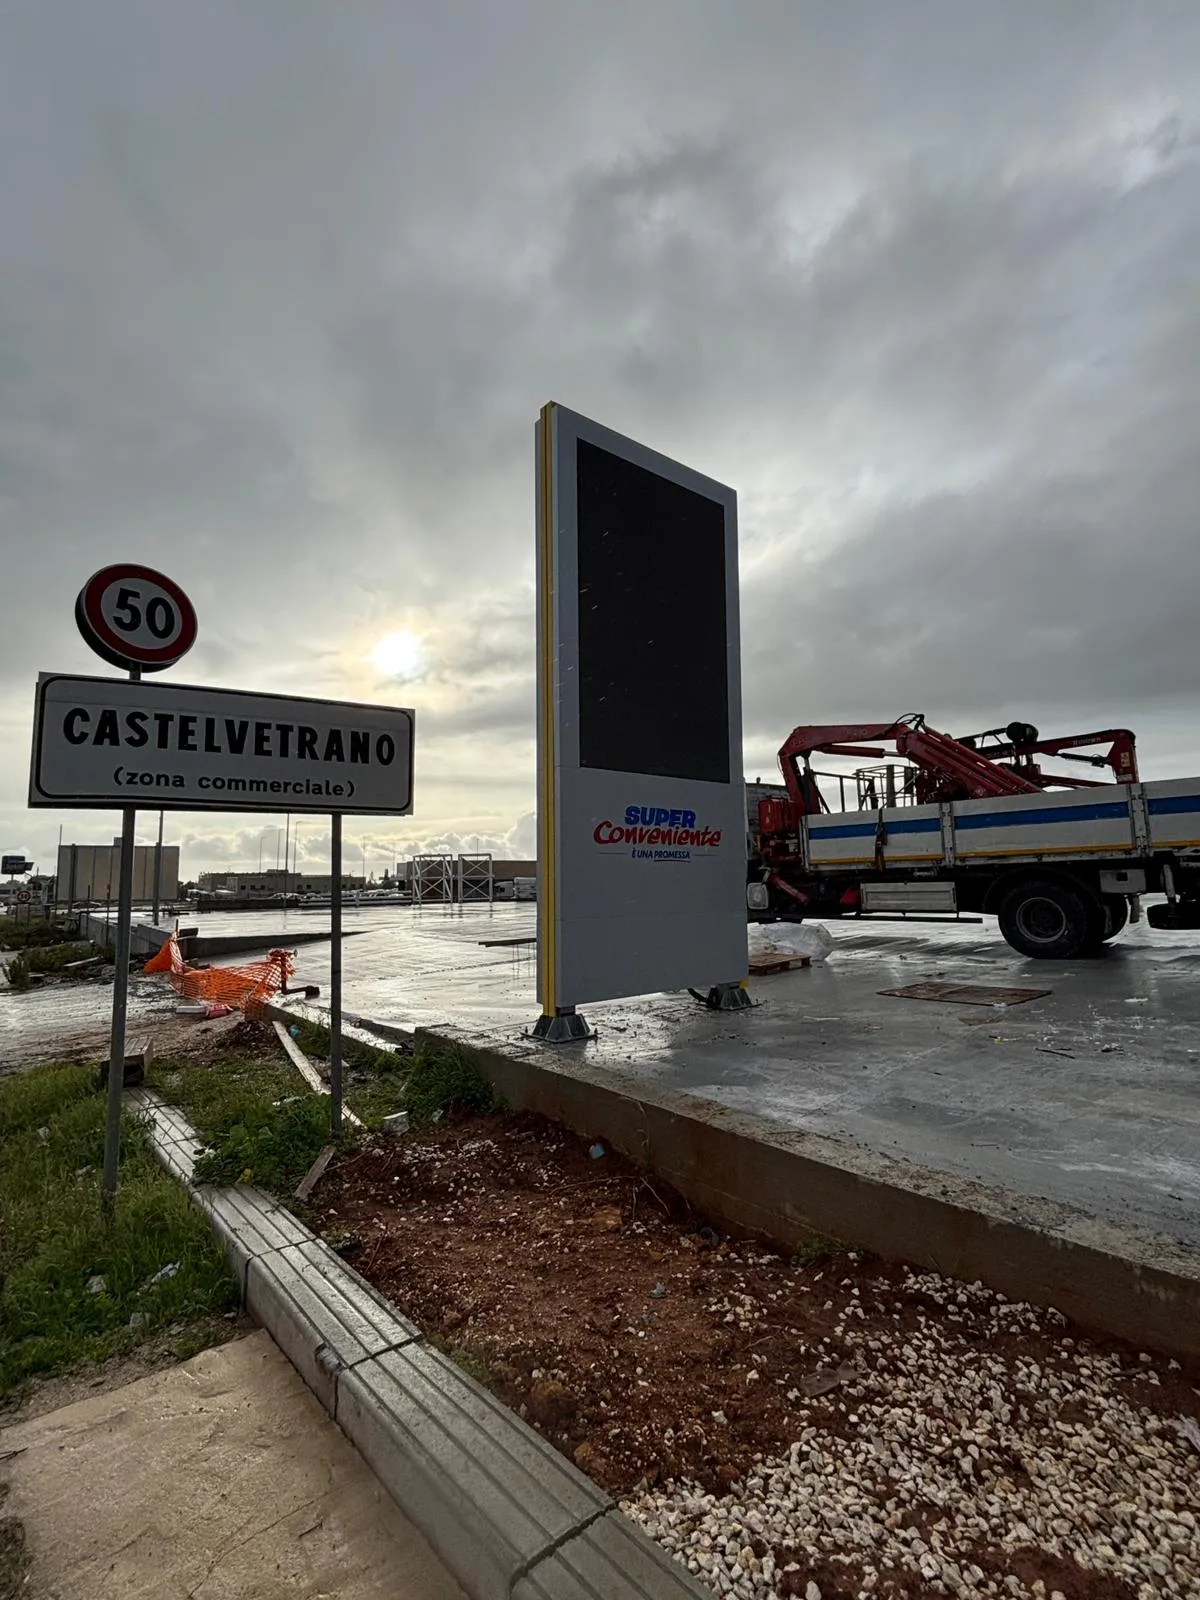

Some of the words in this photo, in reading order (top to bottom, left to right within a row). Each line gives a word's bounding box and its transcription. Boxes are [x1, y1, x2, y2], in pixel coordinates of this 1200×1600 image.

[112, 588, 175, 639] 50
[63, 707, 395, 766] CASTELVETRANO
[113, 766, 185, 789] (zona
[198, 775, 355, 797] commerciale)
[624, 806, 696, 828] SUPER
[593, 820, 722, 847] Conveniente
[637, 849, 653, 858] UNA
[654, 849, 690, 859] PROMESSA
